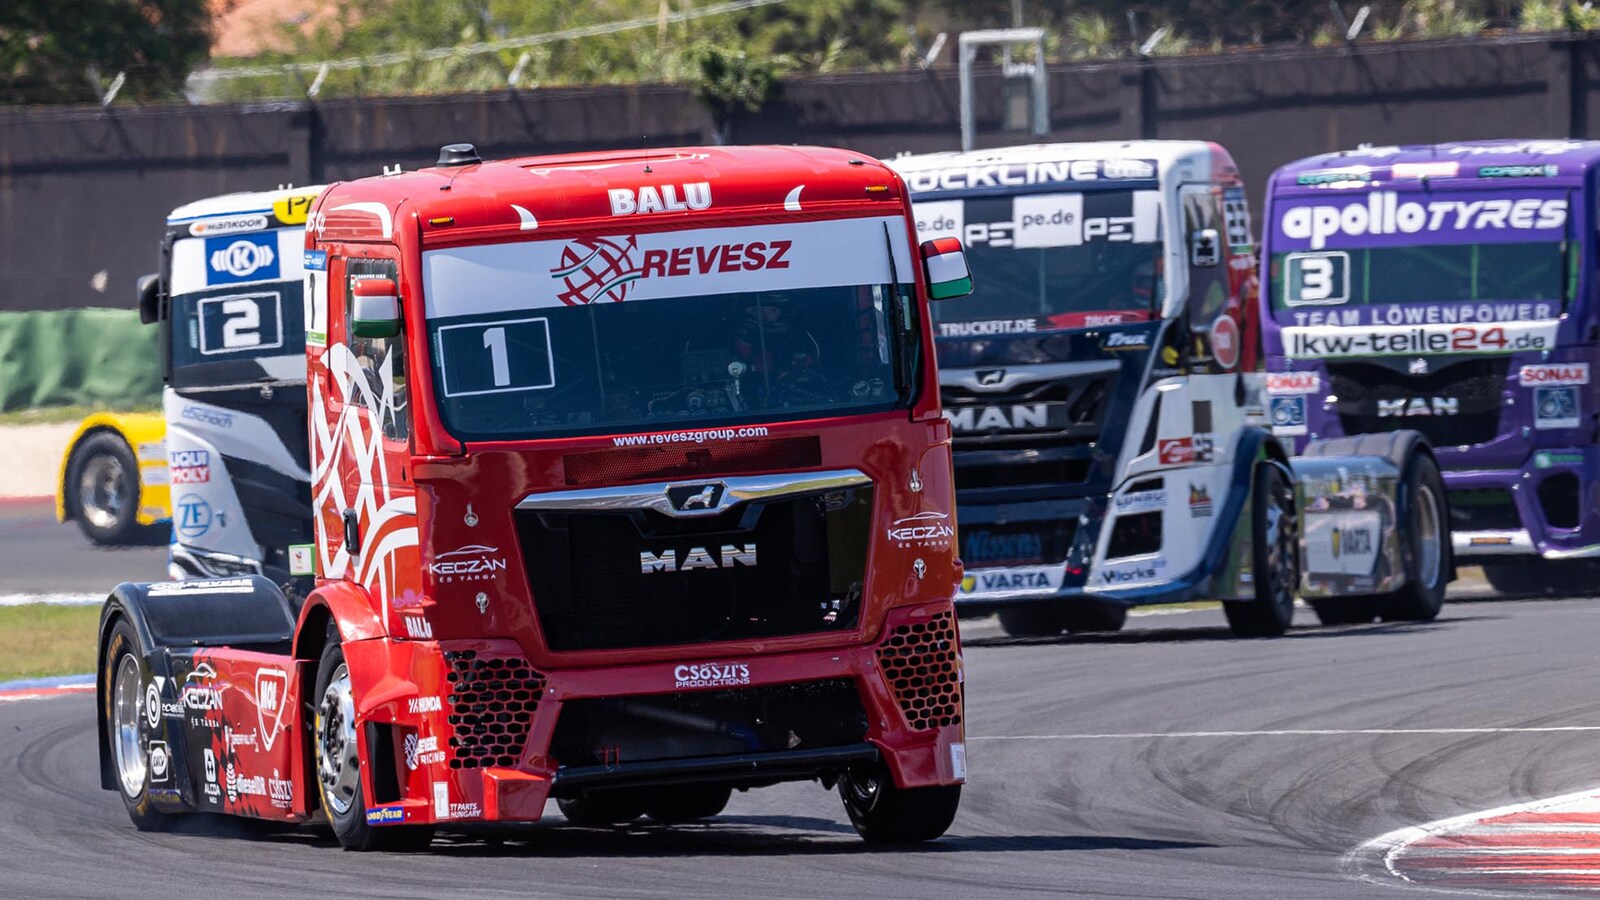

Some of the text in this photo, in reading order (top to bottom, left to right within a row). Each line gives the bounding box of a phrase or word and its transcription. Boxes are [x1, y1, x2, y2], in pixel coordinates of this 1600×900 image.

[608, 182, 713, 216] BALU
[917, 215, 955, 232] e.de
[1022, 209, 1074, 228] pe.de
[641, 240, 793, 279] REVESZ
[1300, 257, 1334, 301] 3
[223, 299, 261, 348] 2
[939, 318, 1037, 336] TRUCKFIT.DE
[1294, 303, 1551, 327] TEAM LÖWENPOWER
[1293, 327, 1546, 356] lkw-teile24.de
[483, 327, 511, 387] 1
[1523, 368, 1585, 383] SONAX
[942, 404, 1048, 430] MAN
[1377, 397, 1459, 418] MAN
[613, 426, 768, 447] www.reveszgroup.com
[178, 503, 208, 529] ZF
[640, 543, 758, 574] MAN
[981, 573, 1050, 589] VARTA
[405, 616, 433, 638] BALU
[675, 677, 751, 688] PRODUCTIONS
